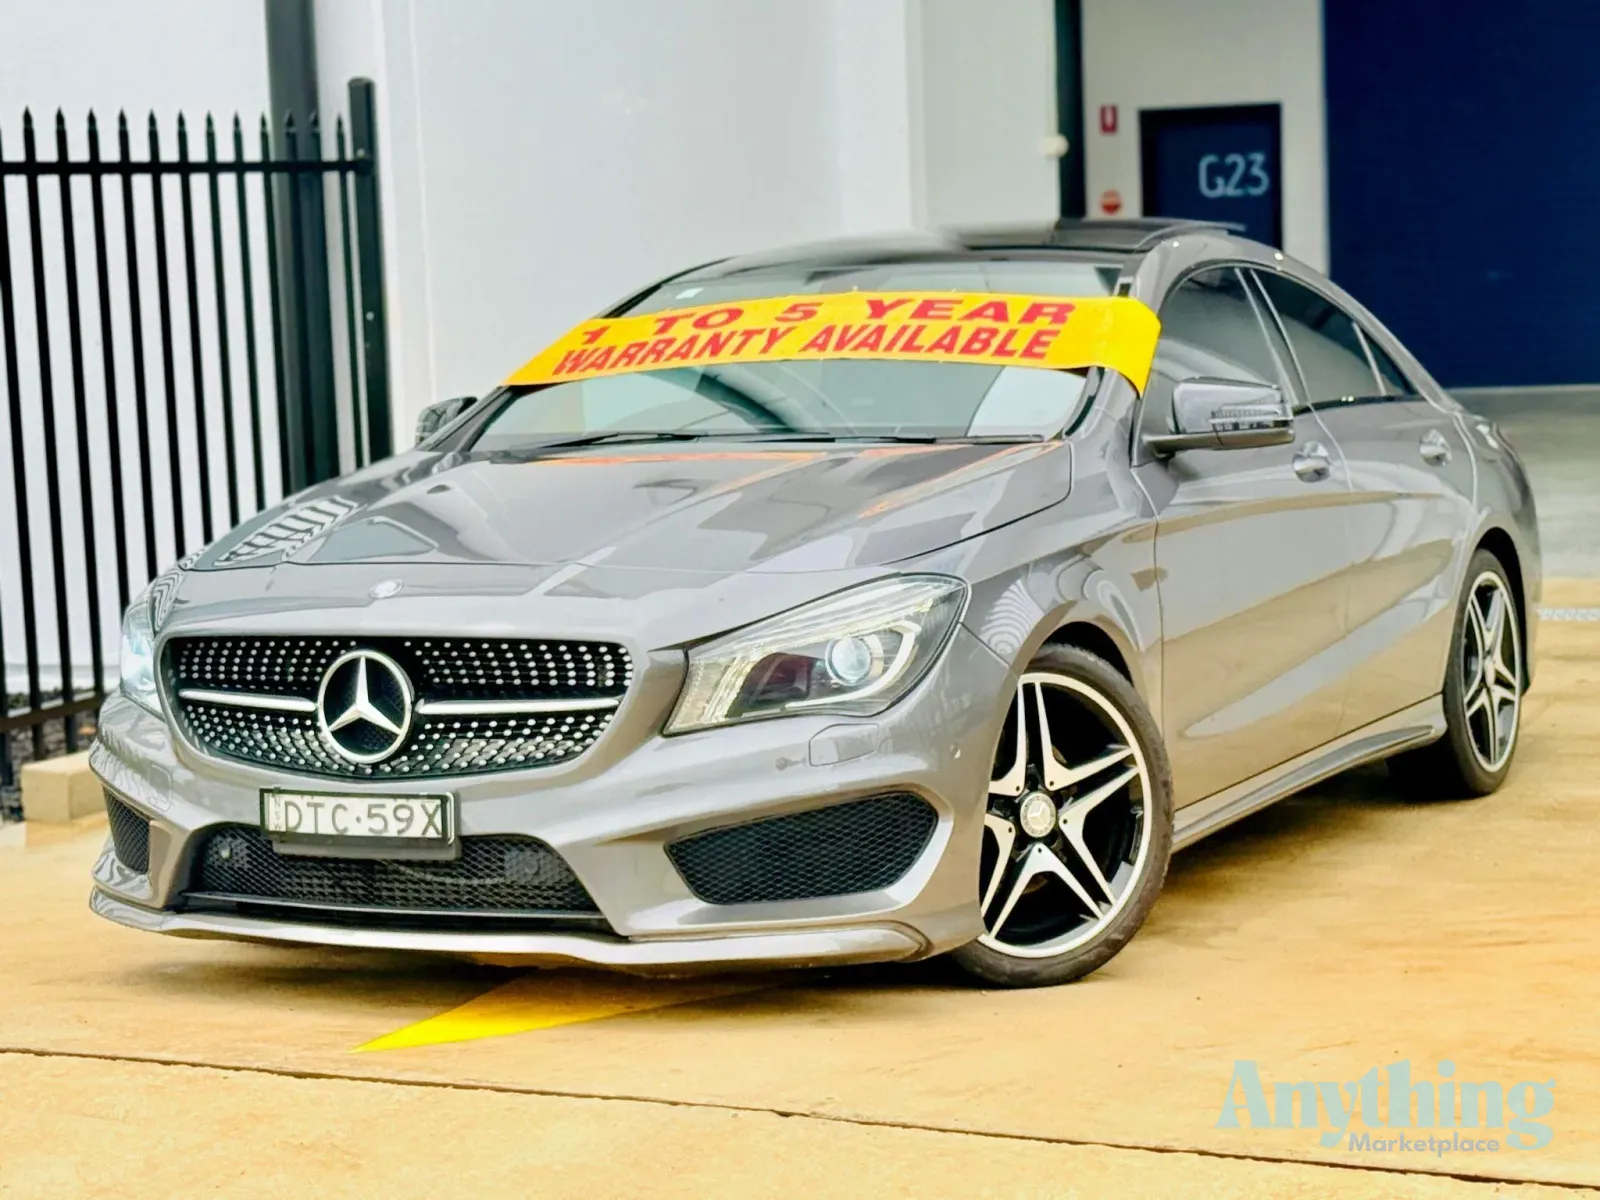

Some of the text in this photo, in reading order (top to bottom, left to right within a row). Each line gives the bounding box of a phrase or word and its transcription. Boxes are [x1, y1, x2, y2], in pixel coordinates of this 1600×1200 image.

[1198, 152, 1269, 198] G23
[582, 299, 1076, 344] 1 TO 5 YEAR
[552, 324, 1062, 376] WARRANTY AVAILABLE
